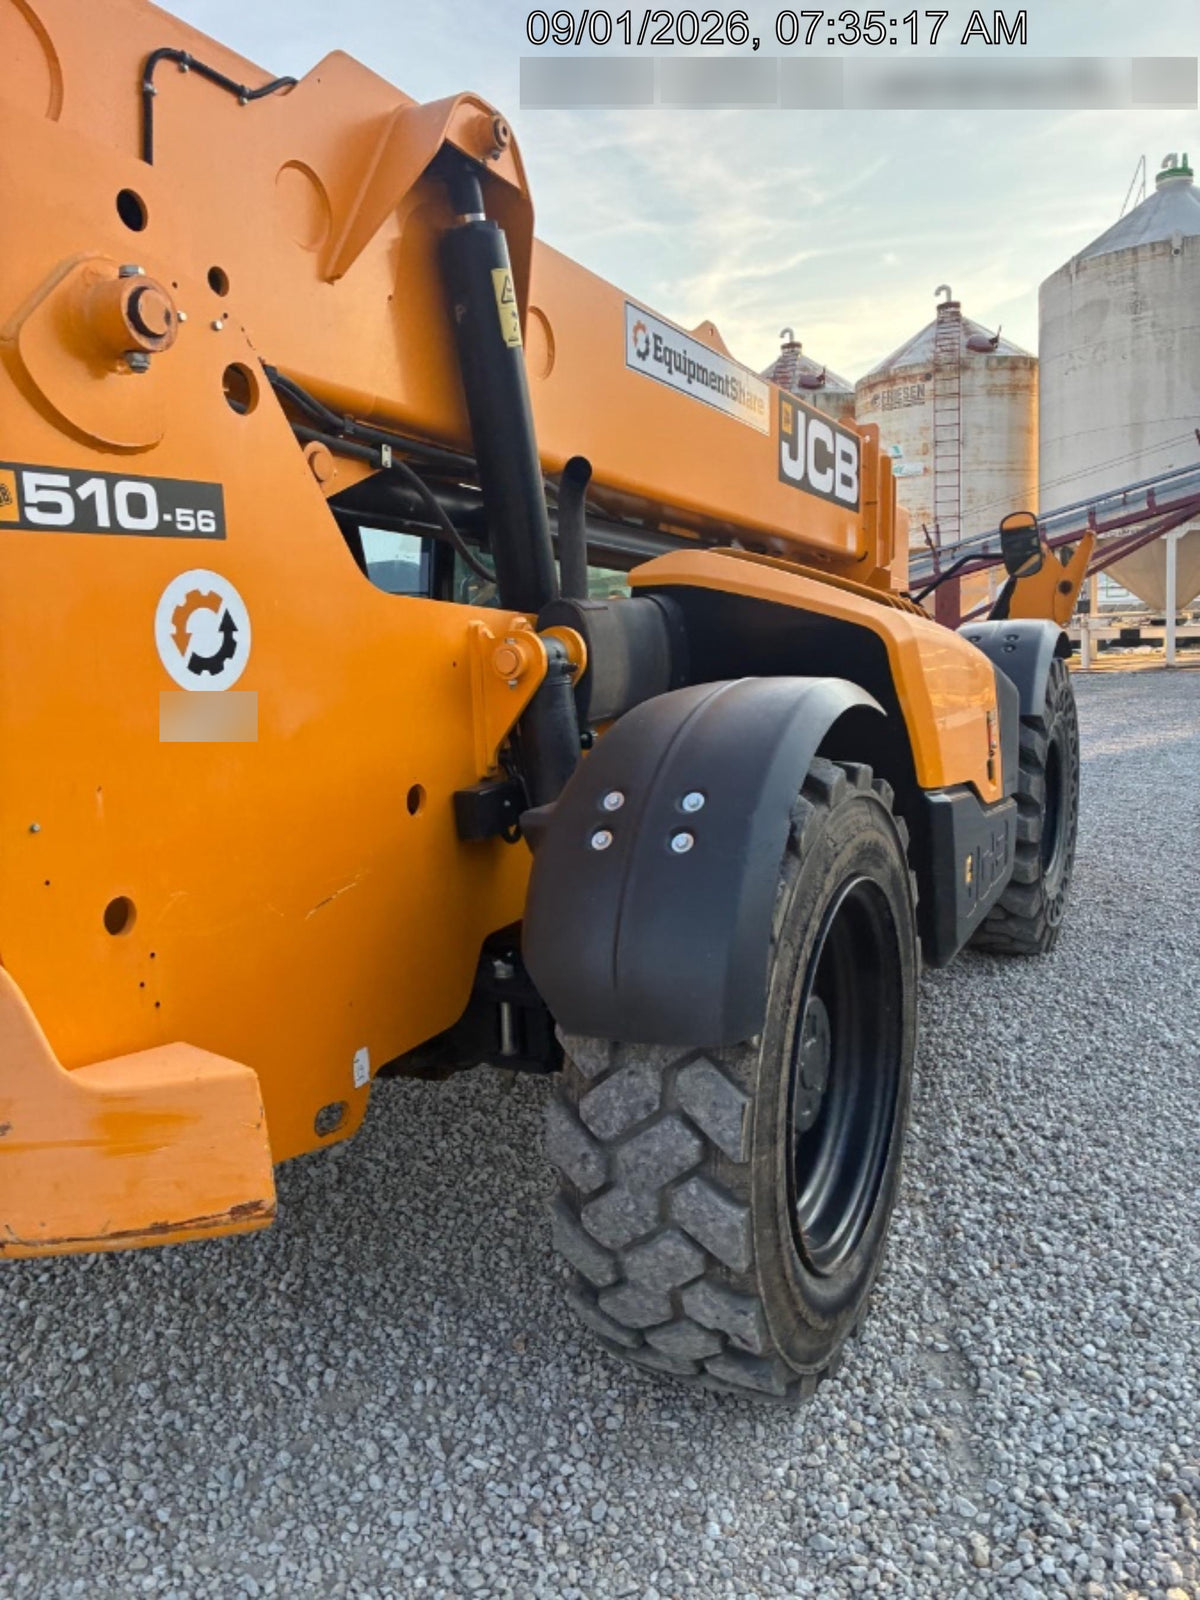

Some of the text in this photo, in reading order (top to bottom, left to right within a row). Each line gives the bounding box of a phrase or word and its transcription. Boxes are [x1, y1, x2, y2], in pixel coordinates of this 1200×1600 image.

[652, 332, 765, 416] EquipmentShare
[881, 383, 926, 403] FRIESEN
[781, 410, 859, 504] JCB
